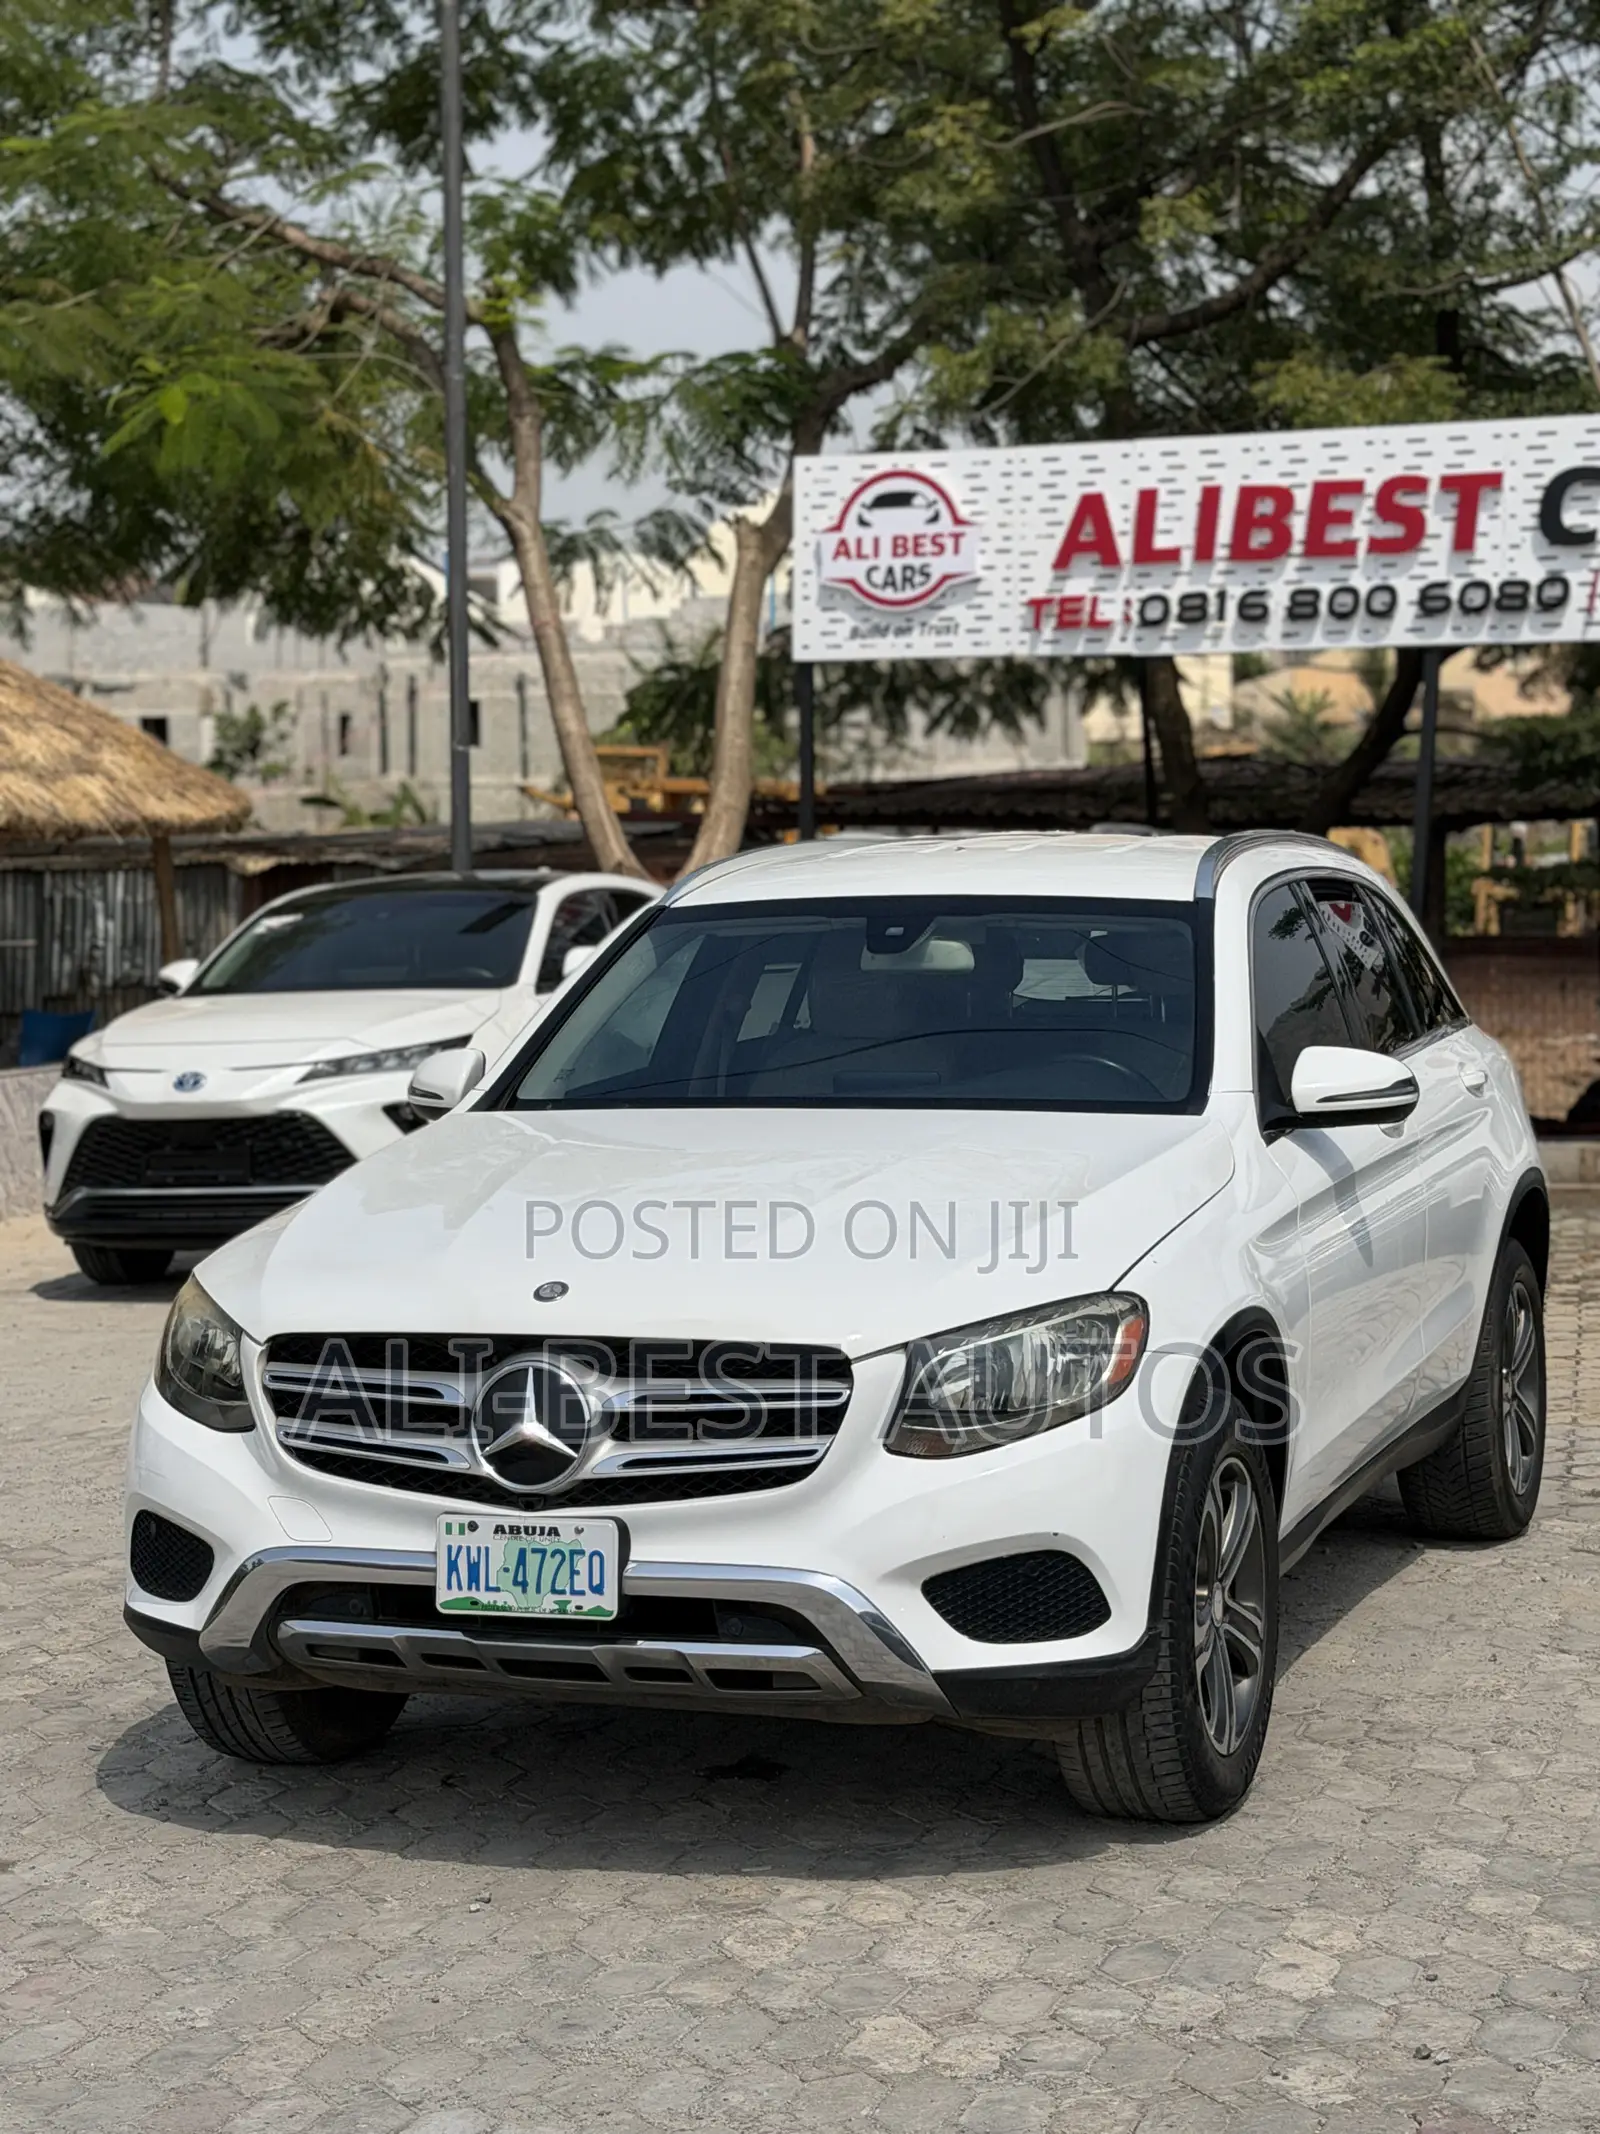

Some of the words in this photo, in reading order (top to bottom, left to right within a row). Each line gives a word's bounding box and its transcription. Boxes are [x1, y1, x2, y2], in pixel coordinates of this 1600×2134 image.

[1051, 472, 1504, 571] ALIBEST
[832, 536, 880, 561] ALI
[891, 532, 966, 559] BEST
[866, 563, 932, 593] CARS
[1287, 585, 1397, 622] 800
[1419, 576, 1570, 615] 6080
[919, 621, 960, 637] Trust
[493, 1524, 561, 1537] ABUJA
